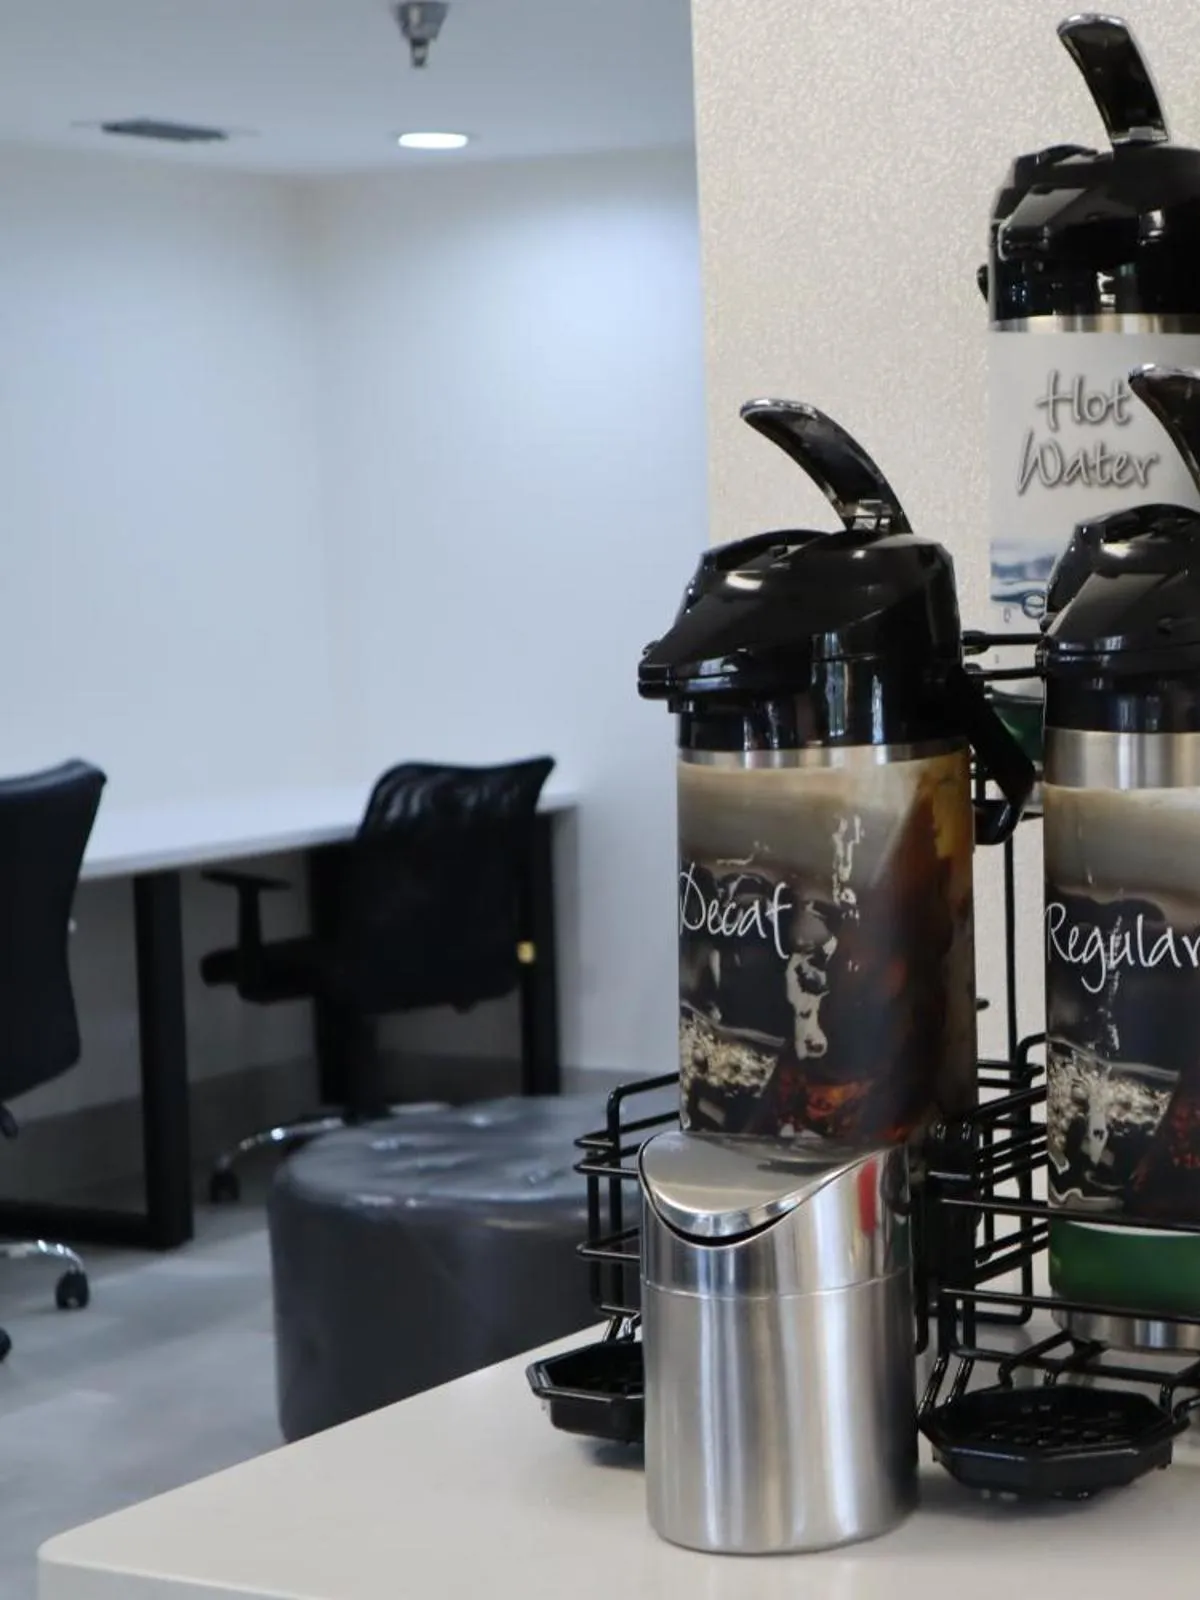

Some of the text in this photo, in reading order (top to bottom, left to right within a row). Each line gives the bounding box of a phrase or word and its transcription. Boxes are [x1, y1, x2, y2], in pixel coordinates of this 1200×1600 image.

[1036, 368, 1133, 432] Hot
[1017, 427, 1163, 496] Water
[678, 863, 794, 960] Decaf
